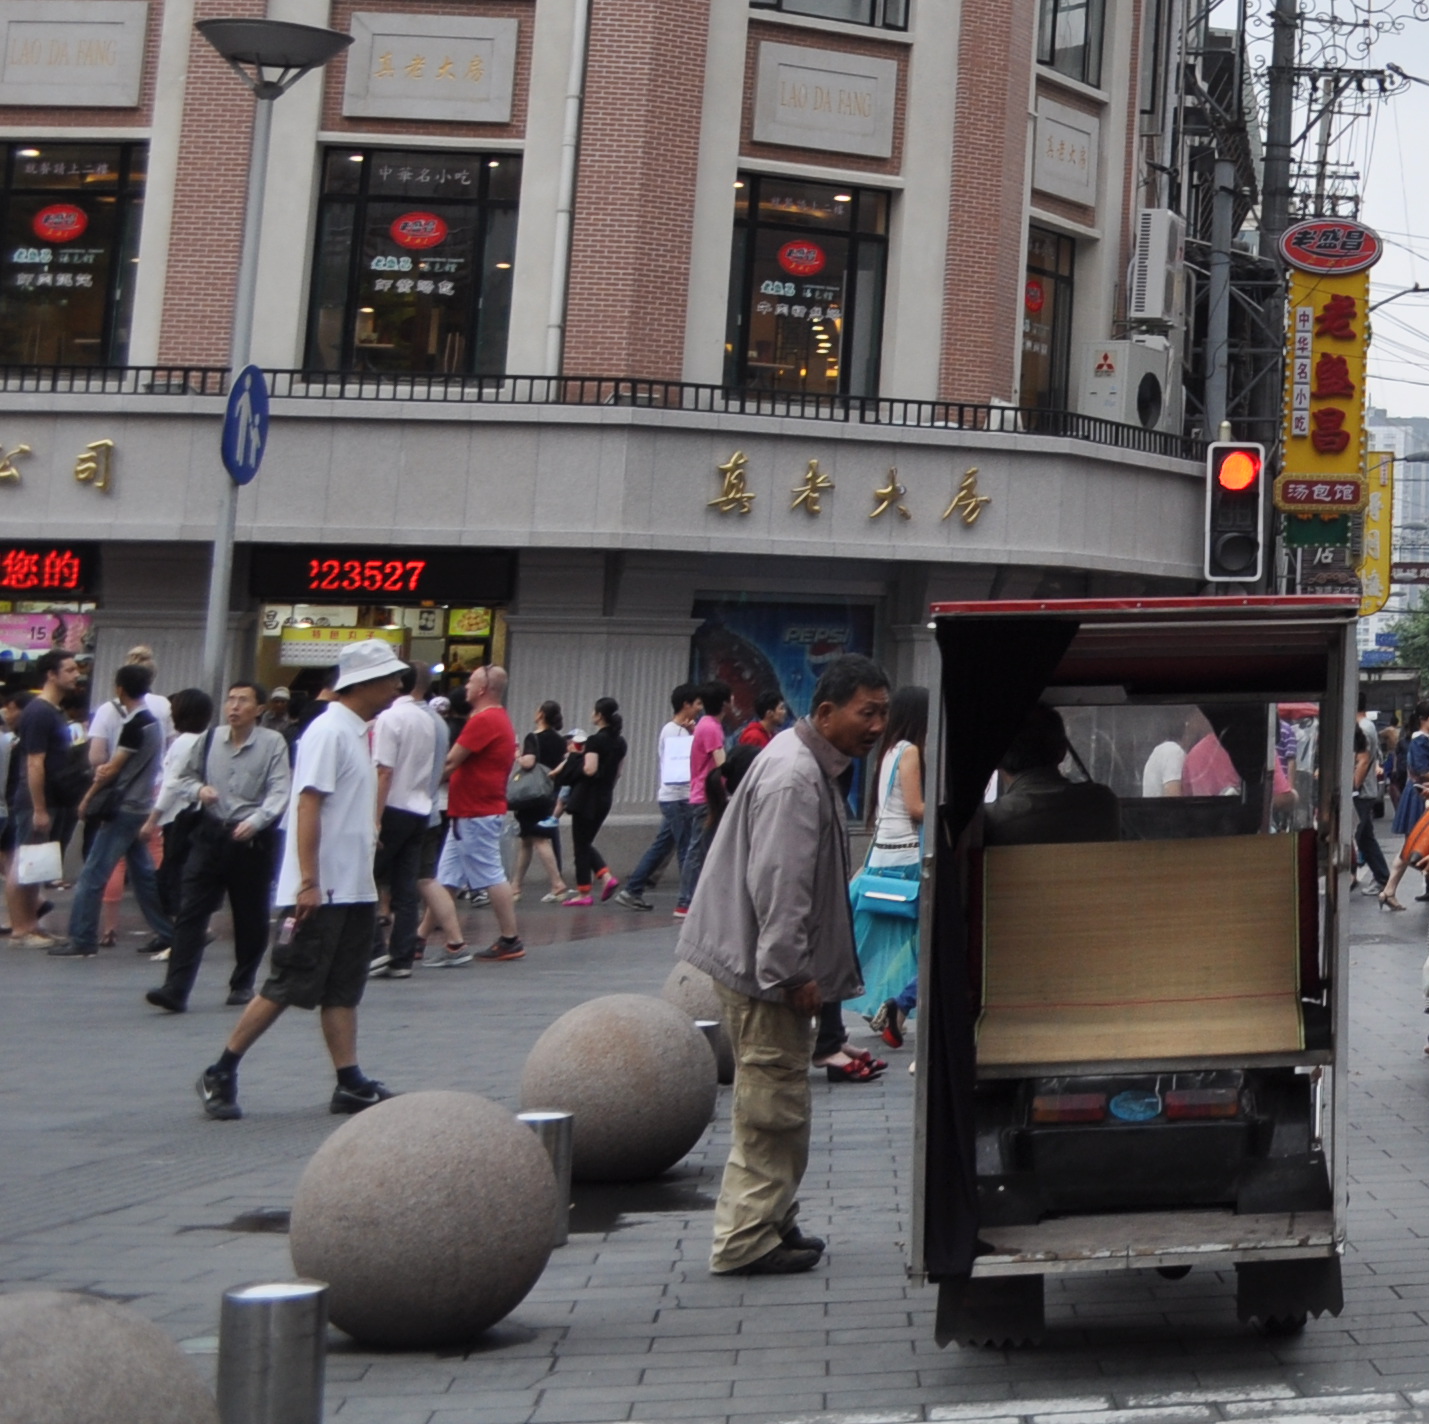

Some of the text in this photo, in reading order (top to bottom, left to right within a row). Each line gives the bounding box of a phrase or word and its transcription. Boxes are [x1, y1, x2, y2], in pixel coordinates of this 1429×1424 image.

[9, 37, 118, 68] LAO DA FANG
[374, 51, 485, 82] 真老大房
[780, 79, 873, 119] LAO DA FANG
[378, 165, 472, 186] 中華名小吃
[1291, 228, 1366, 252] 老盛昌
[1293, 308, 1312, 436] 中华名小吃
[1311, 293, 1358, 454] 老盛昌
[707, 450, 993, 524] 真老大房
[1287, 483, 1355, 502] 汤包馆
[1, 549, 81, 589] 您的
[30, 626, 47, 642] 15
